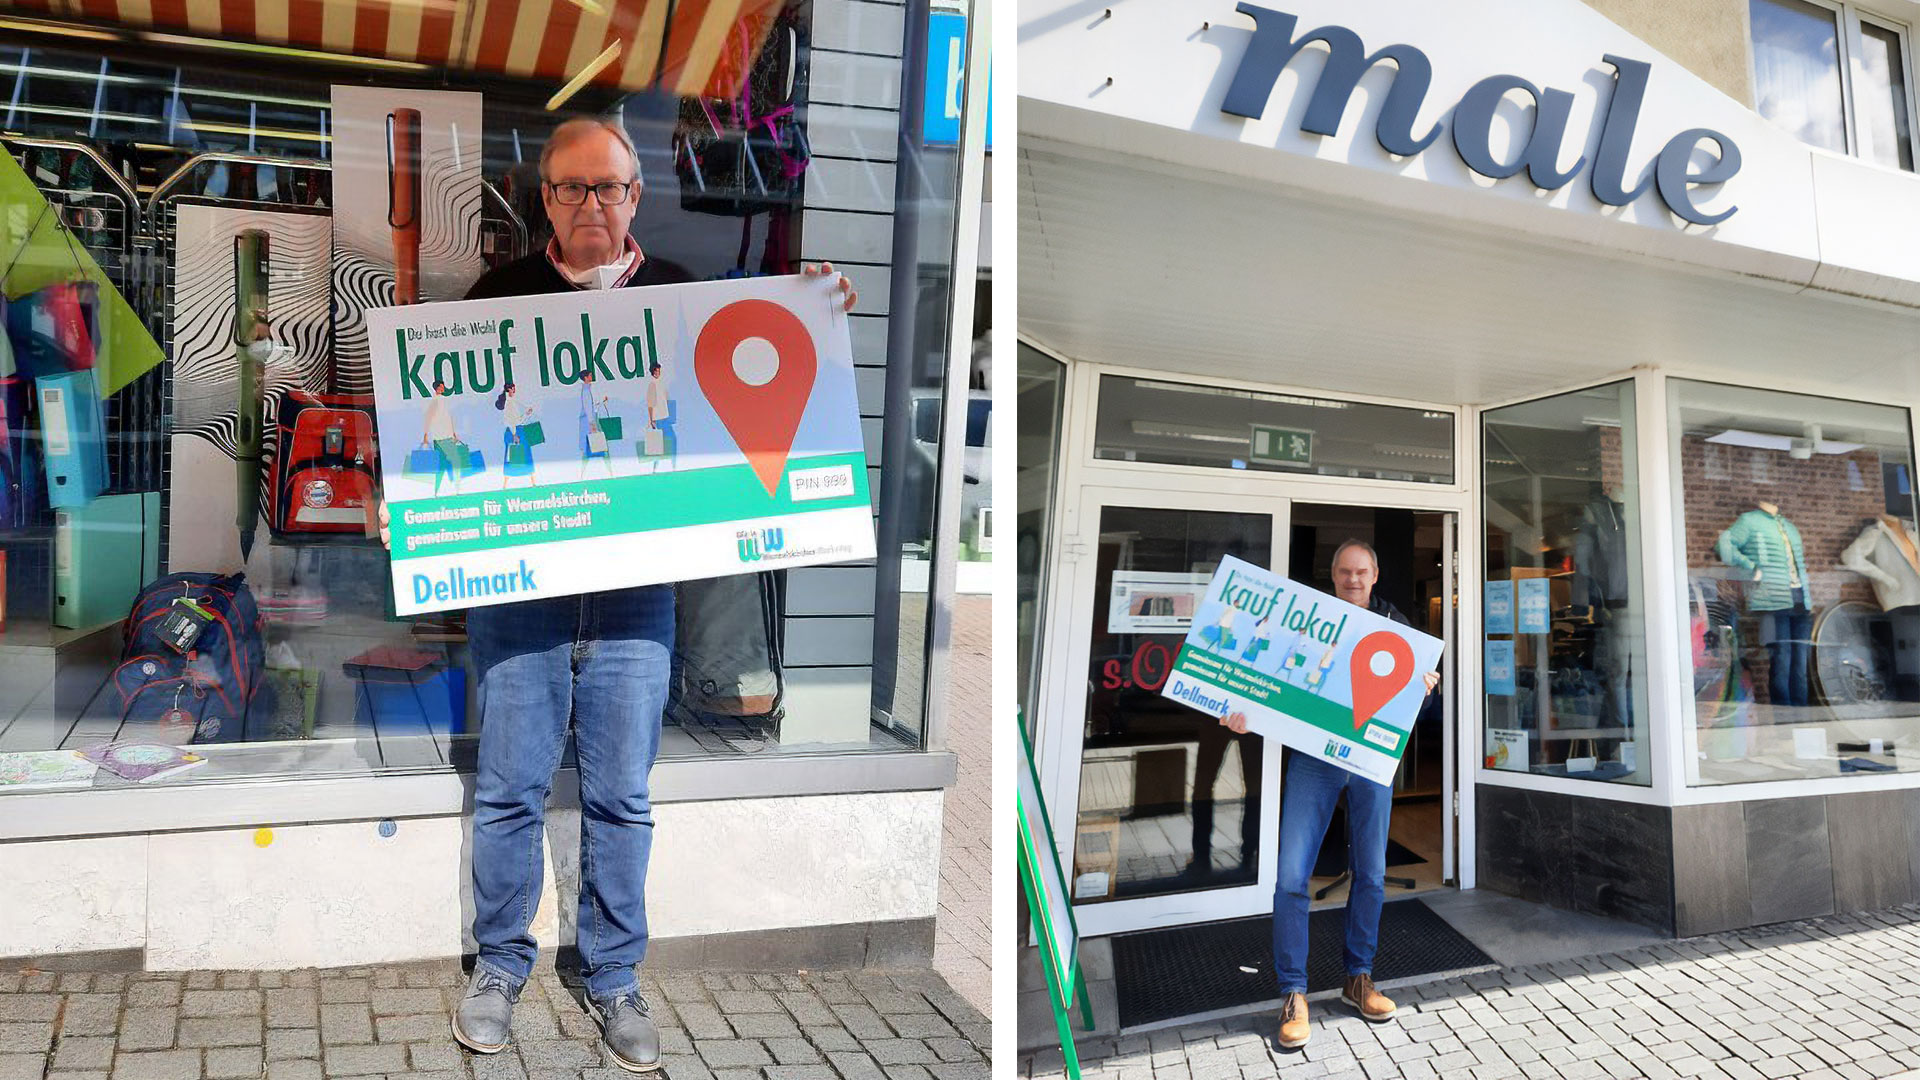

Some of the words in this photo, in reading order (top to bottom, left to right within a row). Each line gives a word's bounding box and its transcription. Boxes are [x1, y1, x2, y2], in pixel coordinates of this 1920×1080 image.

[1221, 1, 1742, 226] male
[396, 318, 516, 400] kauf
[534, 308, 659, 387] lokal
[404, 506, 480, 525] Gemeinsam
[484, 500, 502, 516] für
[507, 490, 611, 513] Wermelskirchen,
[406, 528, 480, 551] gemeinsam
[484, 522, 502, 537] für
[507, 518, 549, 535] unsere
[553, 511, 592, 529] Stadt!
[412, 559, 538, 605] Dellmark
[1219, 569, 1284, 617] kauf
[1280, 593, 1348, 645] lokal
[1172, 680, 1231, 715] Dellmark
